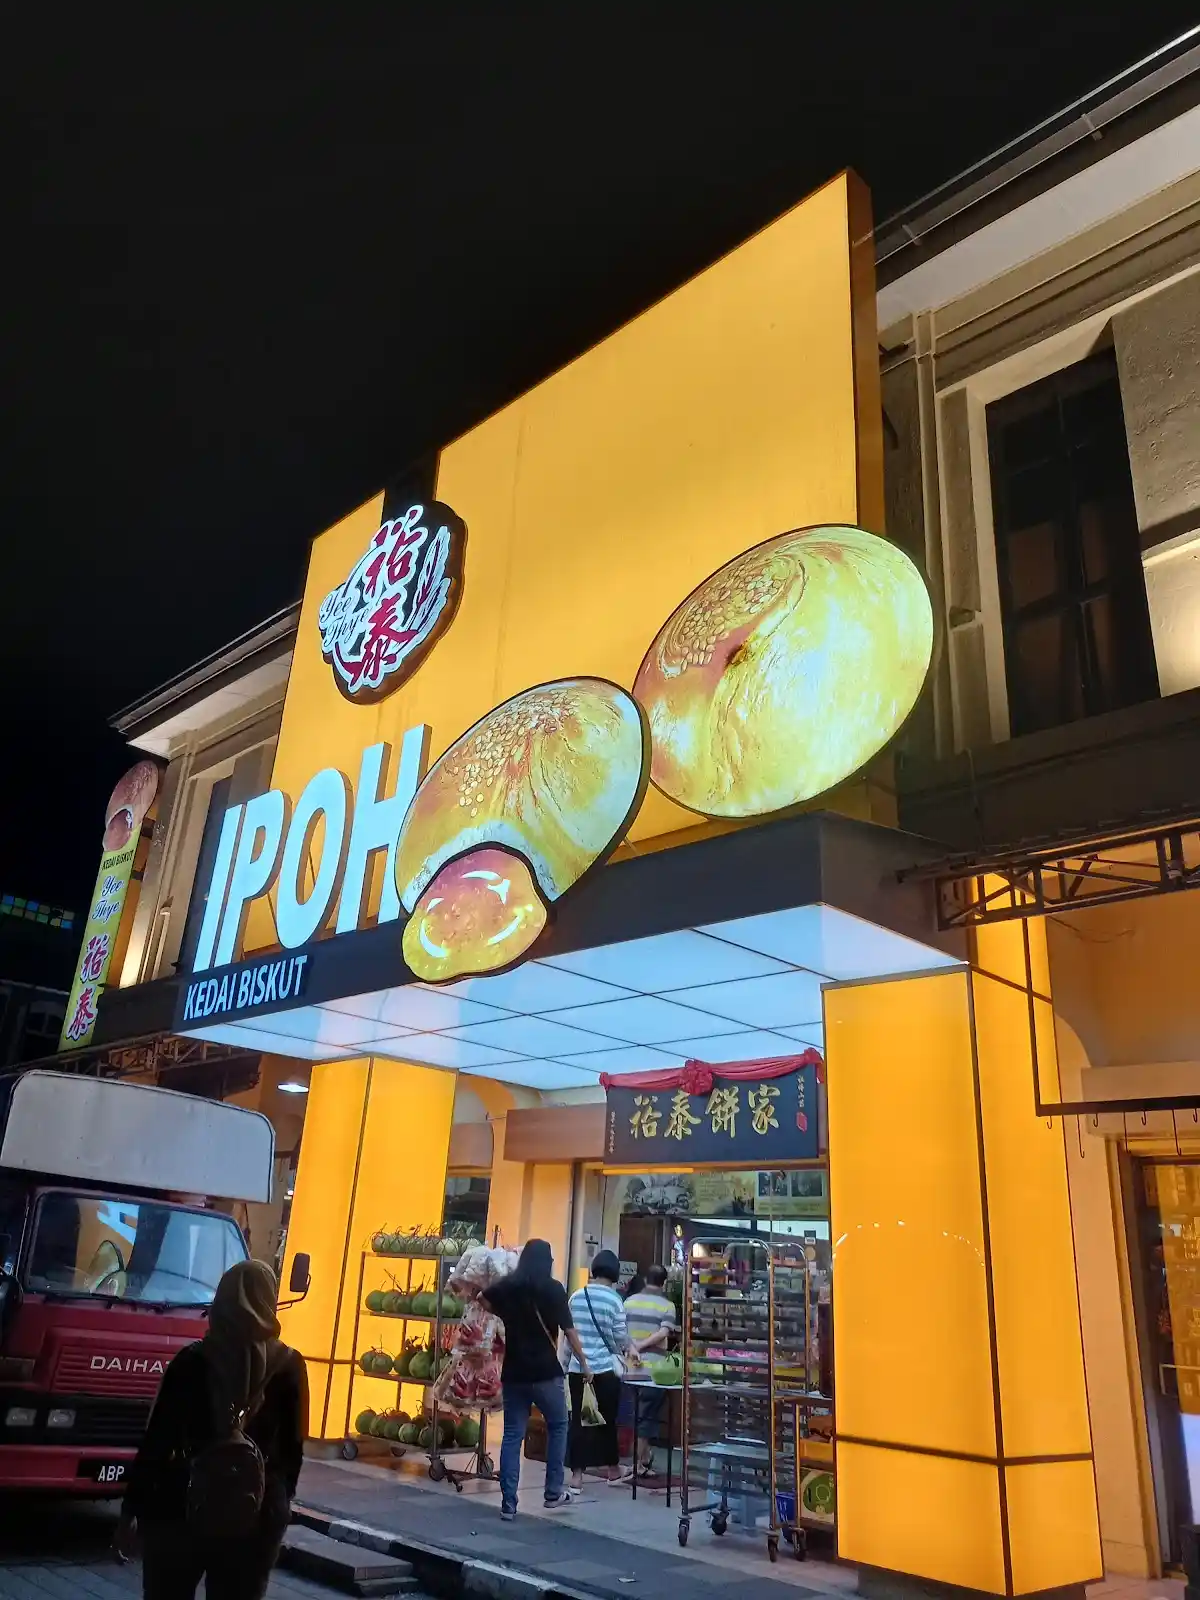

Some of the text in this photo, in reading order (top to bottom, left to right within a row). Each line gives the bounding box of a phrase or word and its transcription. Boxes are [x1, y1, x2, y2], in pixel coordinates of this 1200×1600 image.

[319, 592, 353, 624] Yee
[323, 607, 370, 648] Thye
[193, 724, 428, 973] IPOH
[101, 875, 124, 897] Yee
[91, 899, 120, 924] Thye
[183, 955, 308, 1021] KEDAI BISKUT
[90, 1356, 171, 1374] DAIHA
[97, 1465, 125, 1482] ABP
